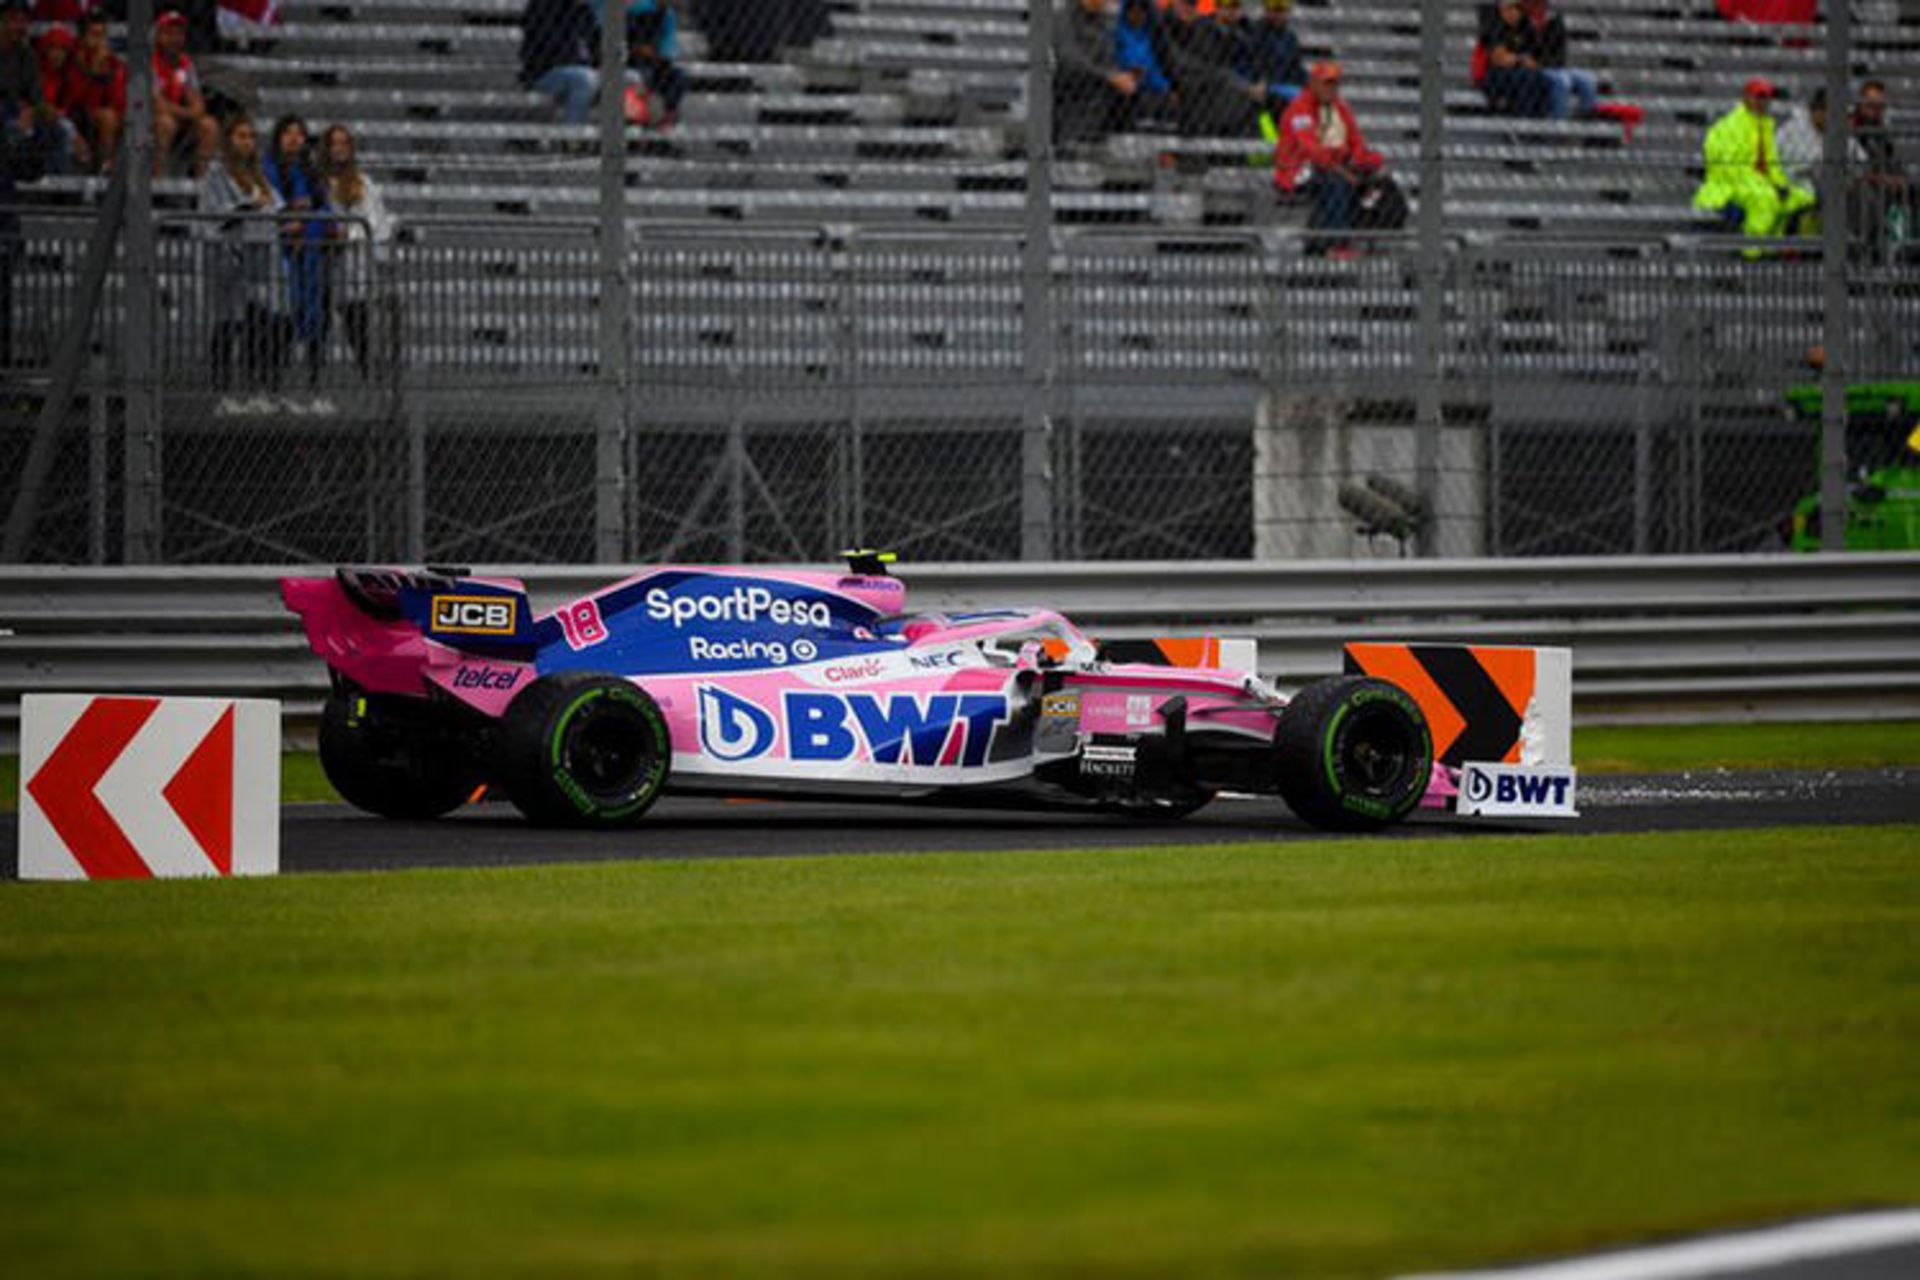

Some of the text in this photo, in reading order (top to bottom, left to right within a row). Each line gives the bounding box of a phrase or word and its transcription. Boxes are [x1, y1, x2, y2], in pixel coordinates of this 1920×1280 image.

[438, 603, 509, 627] JCB
[646, 587, 831, 627] SportPesa
[557, 597, 609, 650] 18
[689, 636, 788, 664] Racing
[909, 651, 966, 669] NEC
[452, 665, 522, 690] telcel
[784, 690, 1011, 768] BWT
[1495, 775, 1570, 805] BWT
